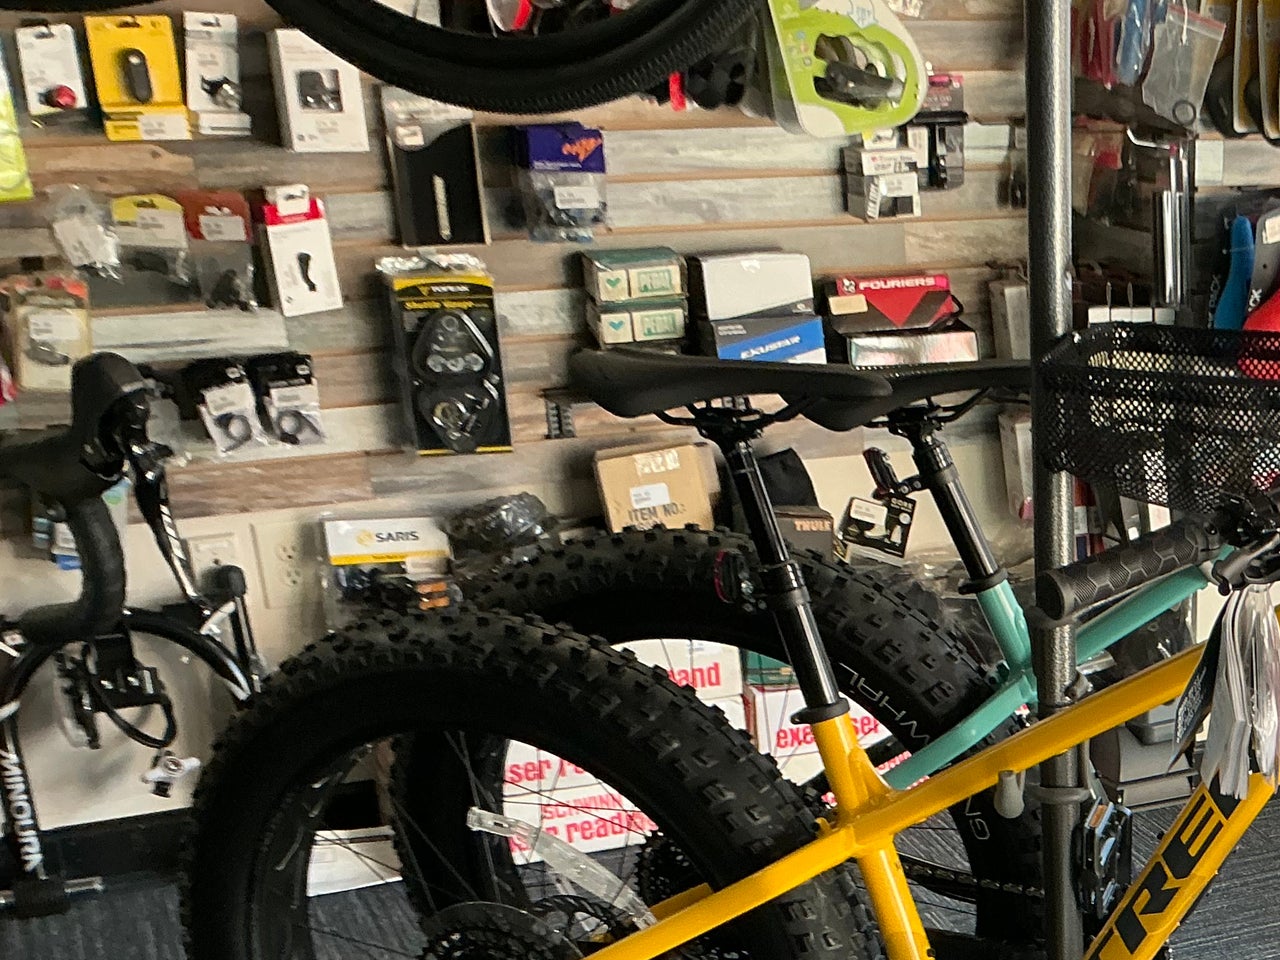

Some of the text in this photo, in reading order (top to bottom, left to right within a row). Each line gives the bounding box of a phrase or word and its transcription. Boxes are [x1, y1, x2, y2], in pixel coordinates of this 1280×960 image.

[859, 276, 936, 291] FOURIERS
[628, 506, 659, 522] ITEM
[794, 519, 832, 532] THULE
[375, 531, 420, 543] SARIS
